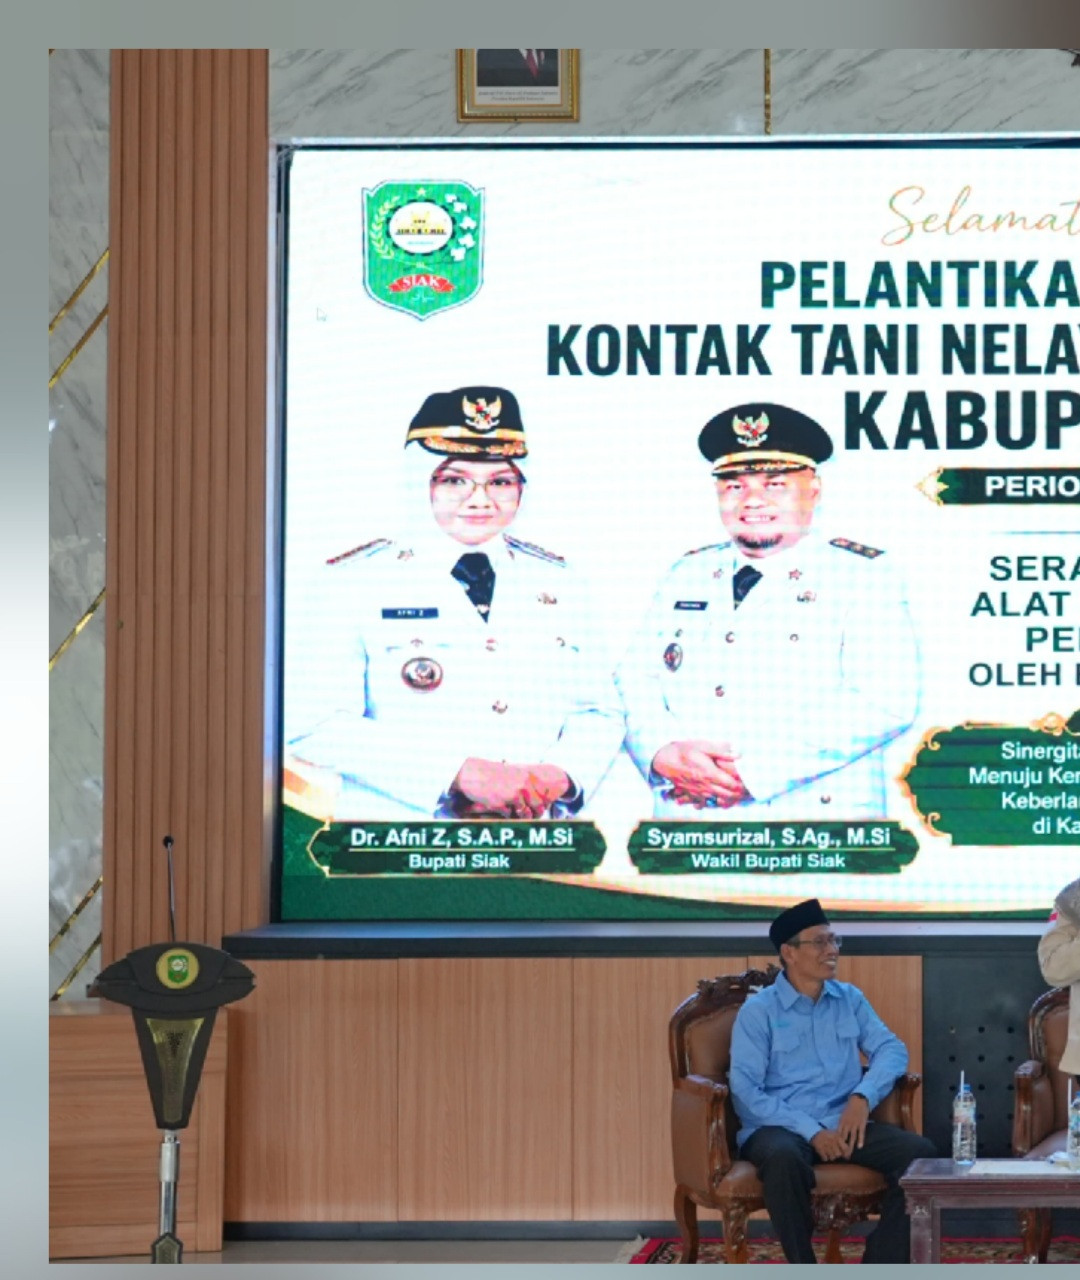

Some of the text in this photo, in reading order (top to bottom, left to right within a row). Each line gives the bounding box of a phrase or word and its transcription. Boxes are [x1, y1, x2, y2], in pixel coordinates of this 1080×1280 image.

[403, 276, 439, 288] SIAK
[547, 324, 772, 376] KONTAK
[791, 324, 918, 376] TANI
[970, 592, 1071, 616] ALAT
[969, 662, 1061, 686] OLEH
[969, 767, 1042, 788] Menuju
[1033, 816, 1051, 834] di
[351, 828, 573, 848] Dr. Afni Z, S.A.P., M.Si
[648, 828, 890, 848] Syamsurizal, S.Ag., M.Si
[409, 854, 510, 870] Bupati Siak
[692, 853, 845, 870] Wakil Bupati Siak
